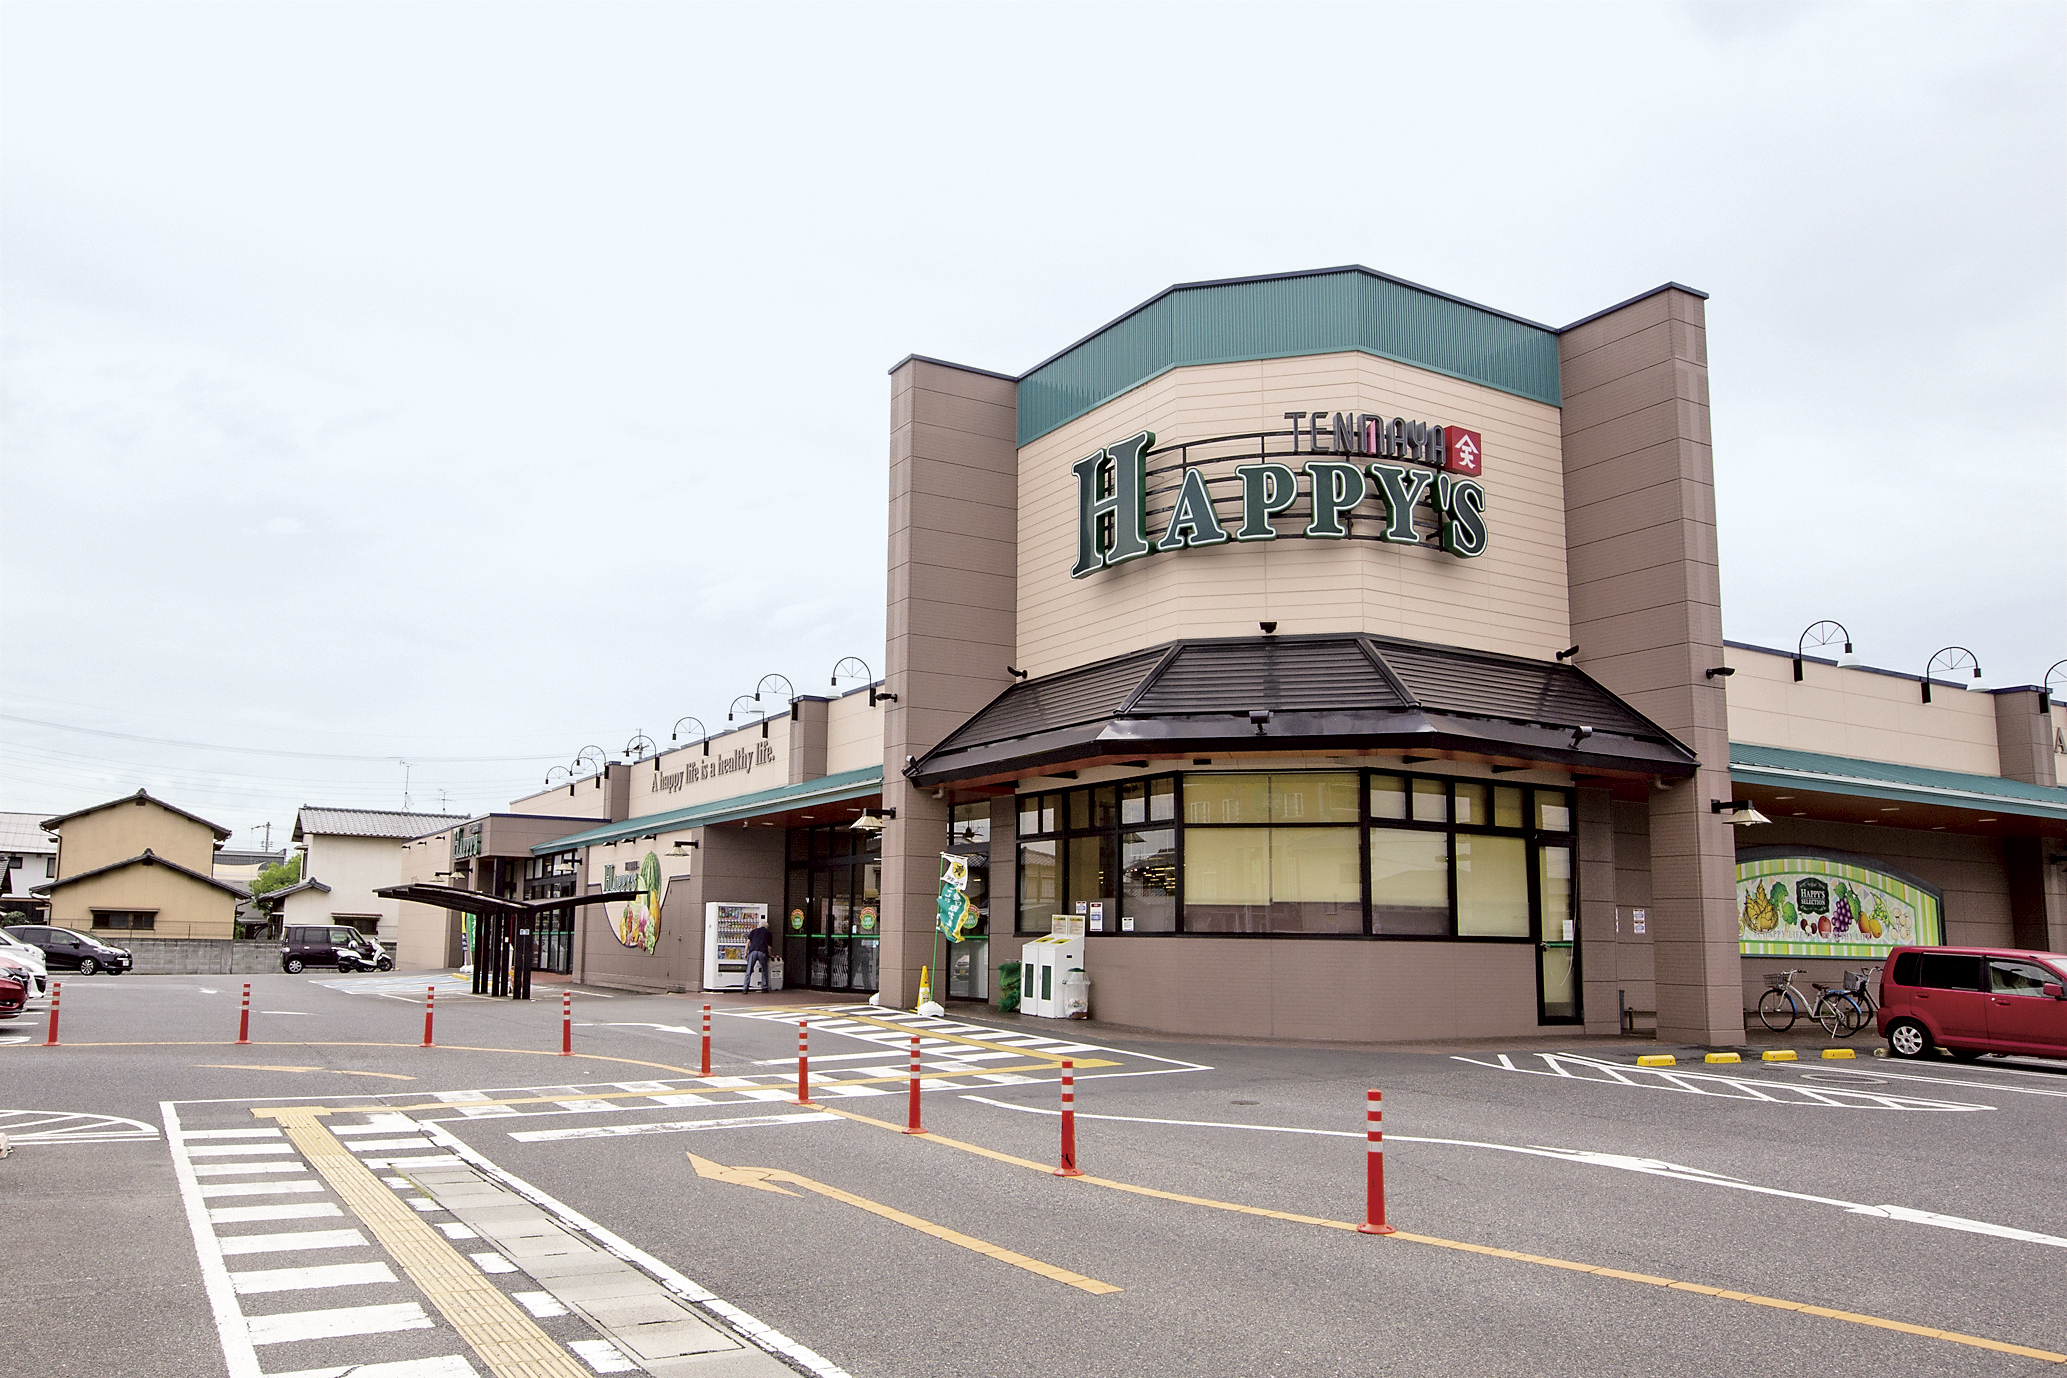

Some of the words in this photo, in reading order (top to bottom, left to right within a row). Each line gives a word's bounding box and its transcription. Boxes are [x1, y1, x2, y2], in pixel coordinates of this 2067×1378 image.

[1284, 411, 1447, 465] TENMAYA
[1070, 430, 1489, 579] HAPPY'S
[651, 772, 659, 793] A
[659, 771, 685, 794] happy
[686, 761, 700, 784] life
[700, 759, 709, 780] is
[710, 762, 716, 778] a
[717, 747, 754, 776] healthy
[755, 740, 776, 766] life.
[2054, 727, 2067, 754] A
